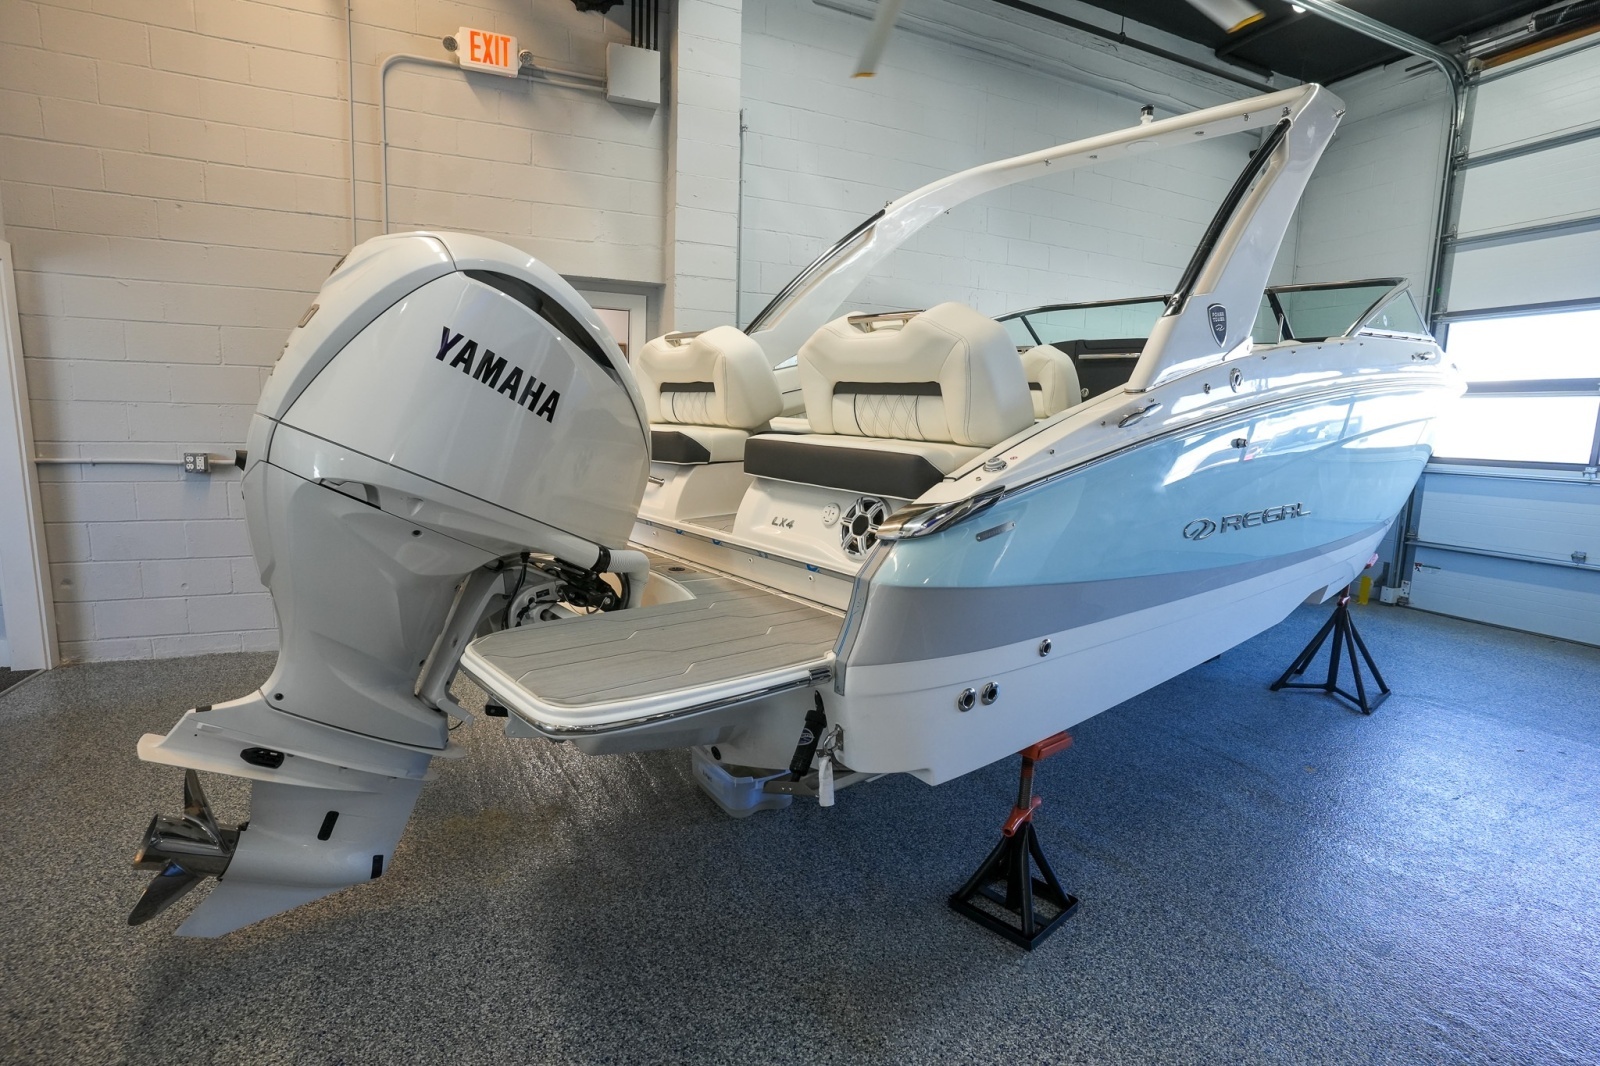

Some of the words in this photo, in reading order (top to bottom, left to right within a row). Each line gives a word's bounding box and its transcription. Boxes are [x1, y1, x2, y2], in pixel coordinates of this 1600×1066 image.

[470, 31, 510, 67] EXIT
[436, 326, 560, 423] YAMAHA
[771, 516, 795, 529] LX4
[1220, 502, 1311, 533] REGAL
